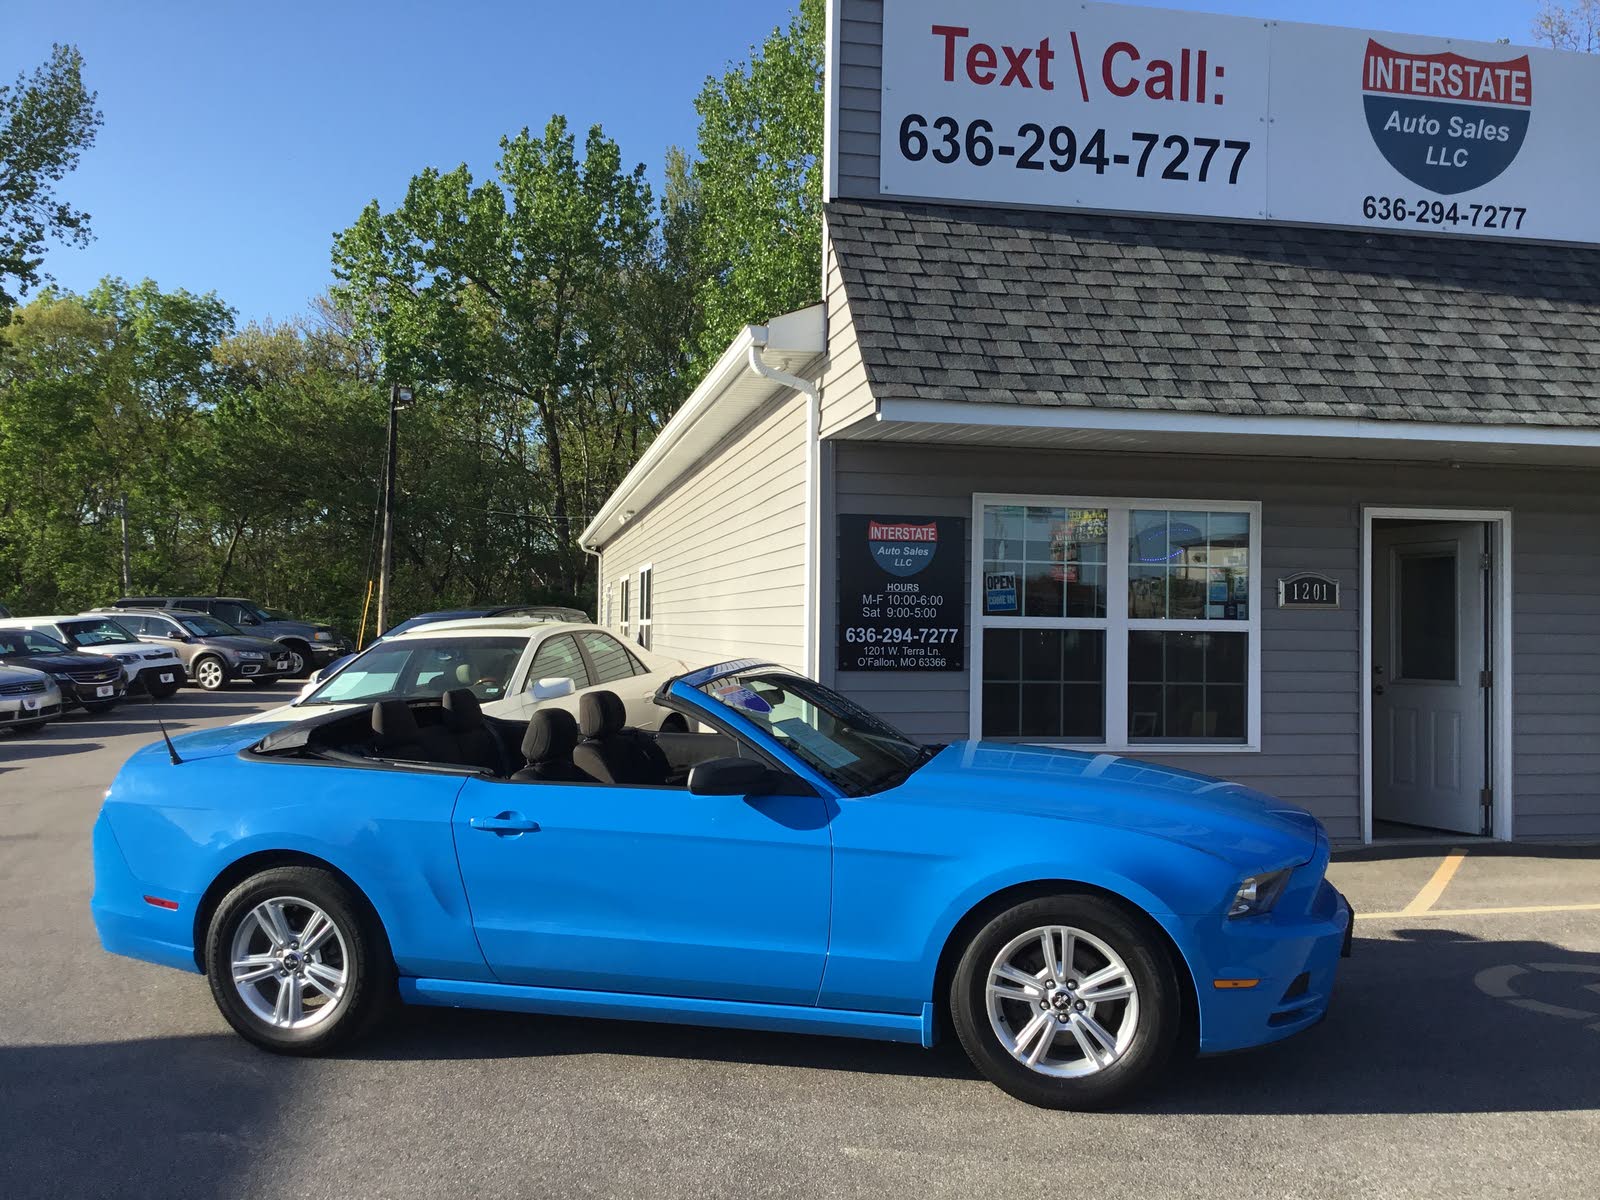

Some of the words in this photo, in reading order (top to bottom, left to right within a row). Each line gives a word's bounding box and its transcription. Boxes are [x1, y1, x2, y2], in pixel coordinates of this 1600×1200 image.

[931, 24, 1055, 91] Text
[1101, 41, 1225, 105] Call:
[1368, 55, 1527, 103] INTERSTATE
[1383, 110, 1441, 136] Auto
[1447, 115, 1511, 142] Sales
[899, 113, 1251, 185] 636-294-7277
[1425, 145, 1469, 168] LLC
[1362, 195, 1528, 230] 636-294-7277
[870, 526, 937, 542] INTERSTATE
[877, 546, 901, 556] Auto
[903, 546, 929, 557] Sales
[894, 558, 913, 568] LLC
[886, 583, 920, 592] HOURS
[987, 575, 1015, 590] OPEN
[1293, 582, 1328, 601] 1201
[862, 594, 884, 605] M-F
[887, 594, 944, 606] 10:00-6:00
[862, 606, 881, 618] Sat
[886, 607, 937, 619] 9:00-5:00
[845, 627, 959, 644] 636-294-7277
[864, 646, 886, 656] 1201
[887, 646, 900, 656] W.
[902, 646, 925, 656] Terra
[927, 646, 942, 656] Ln.
[857, 657, 898, 668] O'Fallon,
[900, 657, 917, 667] MO
[918, 658, 947, 668] 63366
